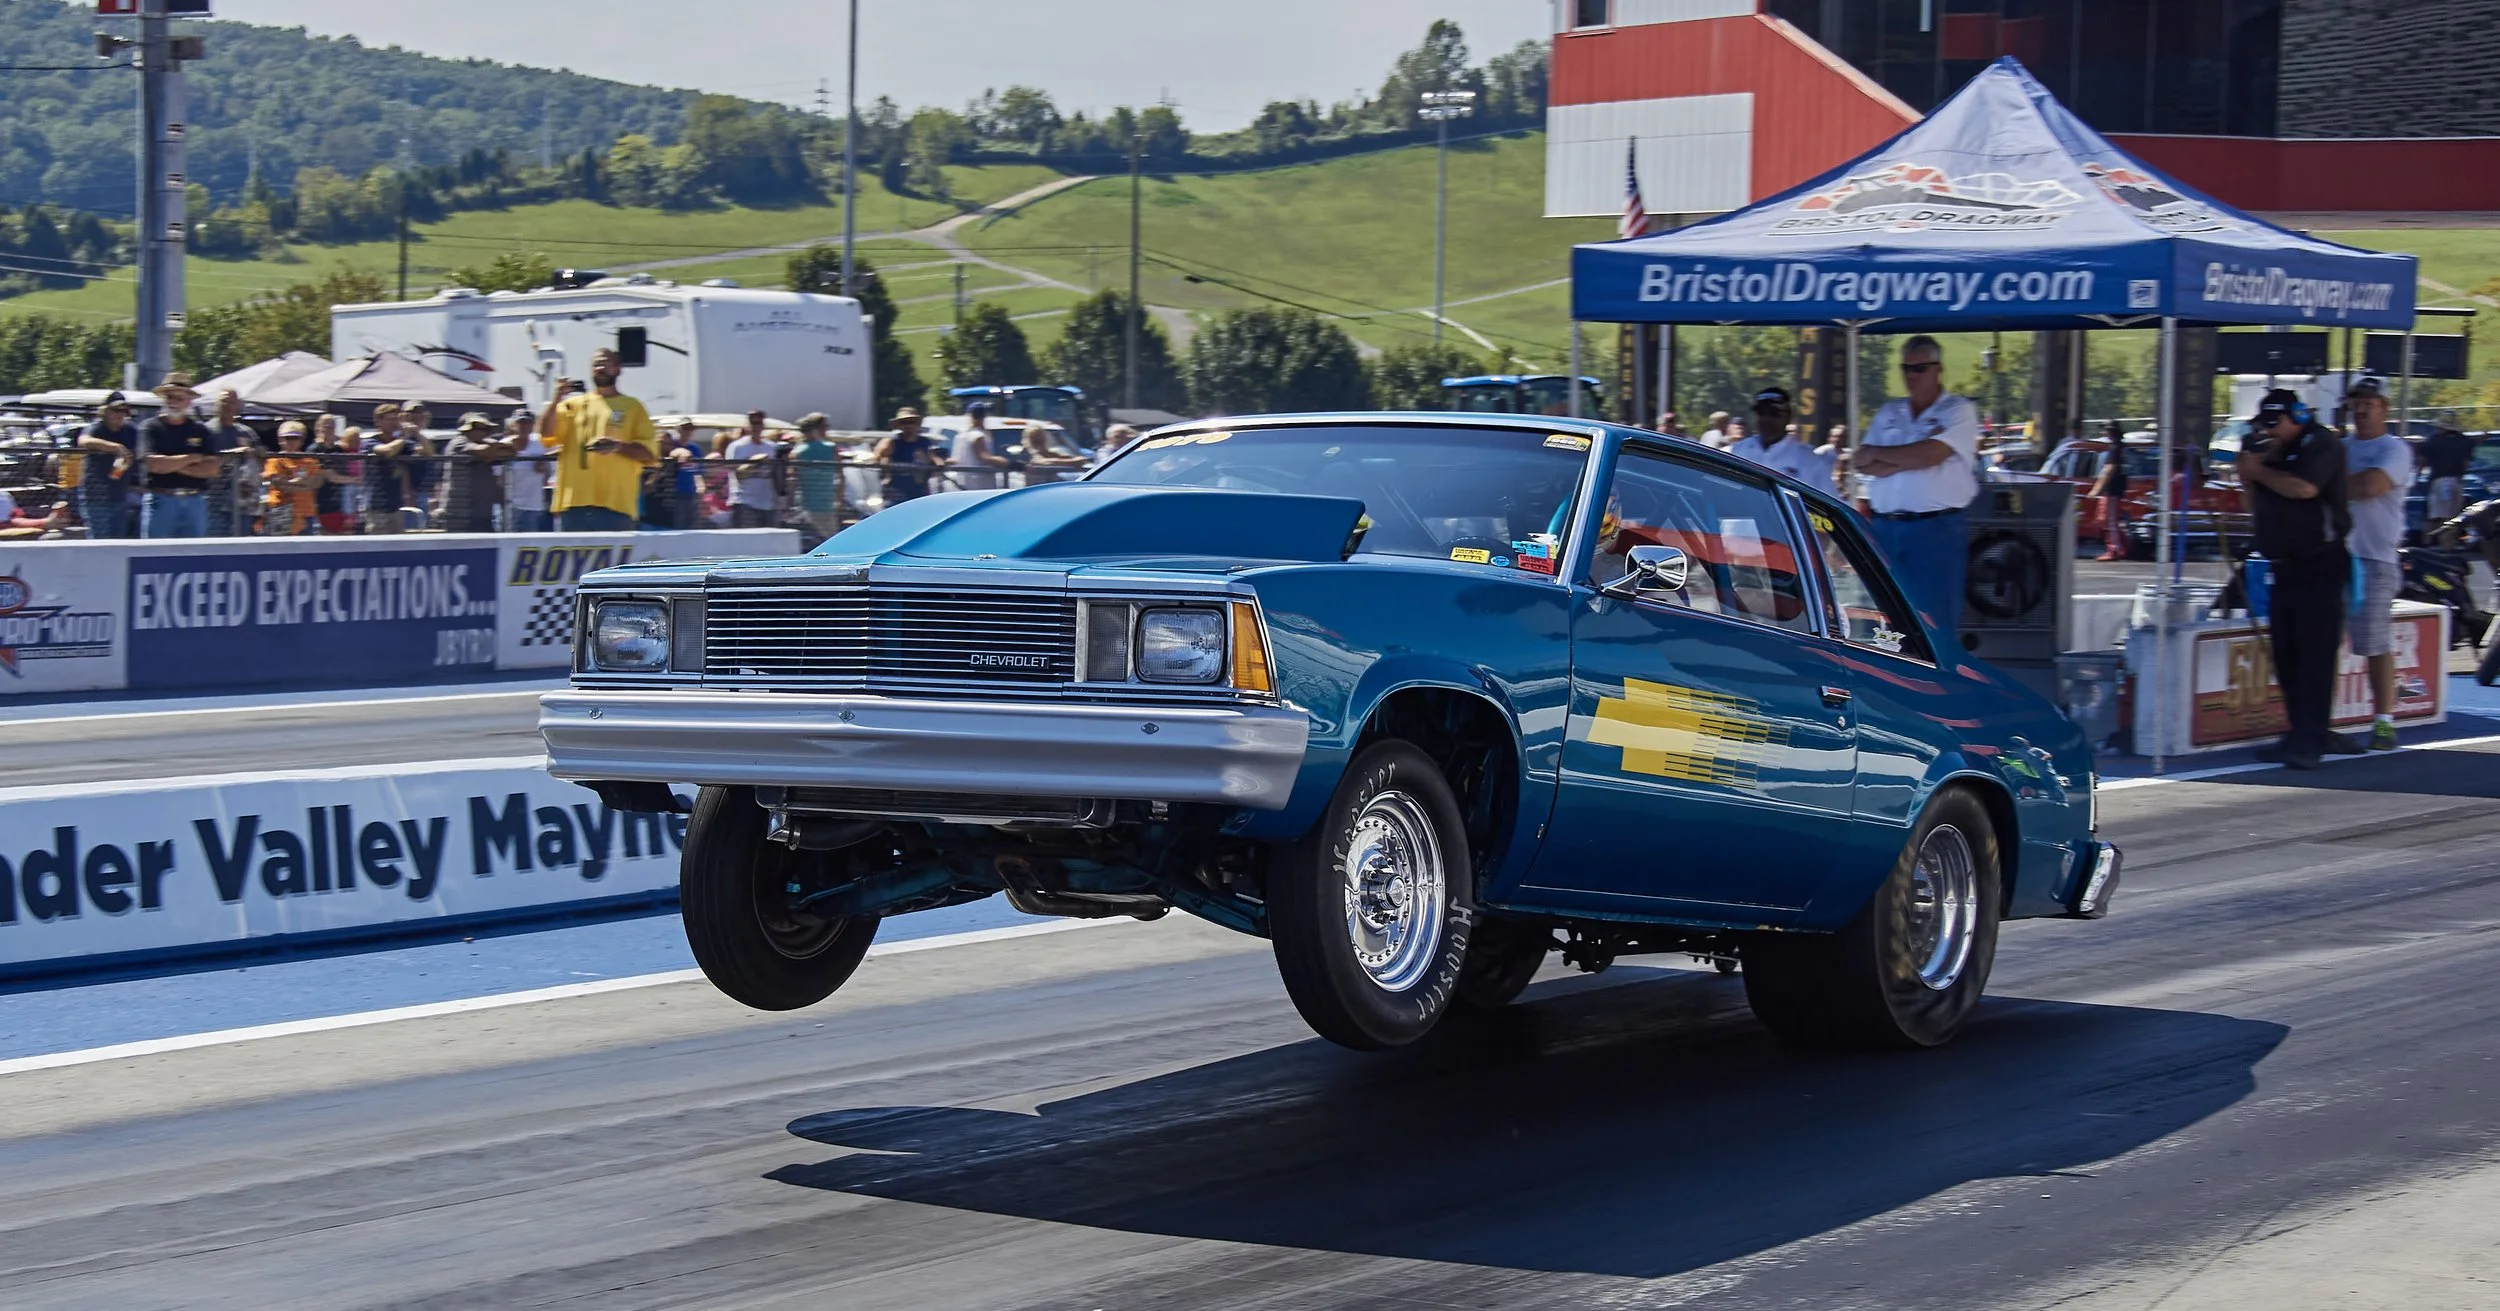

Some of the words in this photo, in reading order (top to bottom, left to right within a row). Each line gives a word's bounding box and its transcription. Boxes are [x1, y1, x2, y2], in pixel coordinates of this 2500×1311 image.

[1775, 211, 1899, 230] BRISTOL
[1911, 210, 2064, 226] DRAGWAY
[1638, 262, 2095, 311] BristolDragway.com
[2203, 262, 2395, 319] BristolDragway.com
[132, 571, 250, 630] EXCEED
[255, 564, 496, 626] EXPECTATIONS...
[970, 654, 1048, 668] CHEVROLET
[193, 804, 450, 904] Valley
[1417, 896, 1473, 1022] Hoosier
